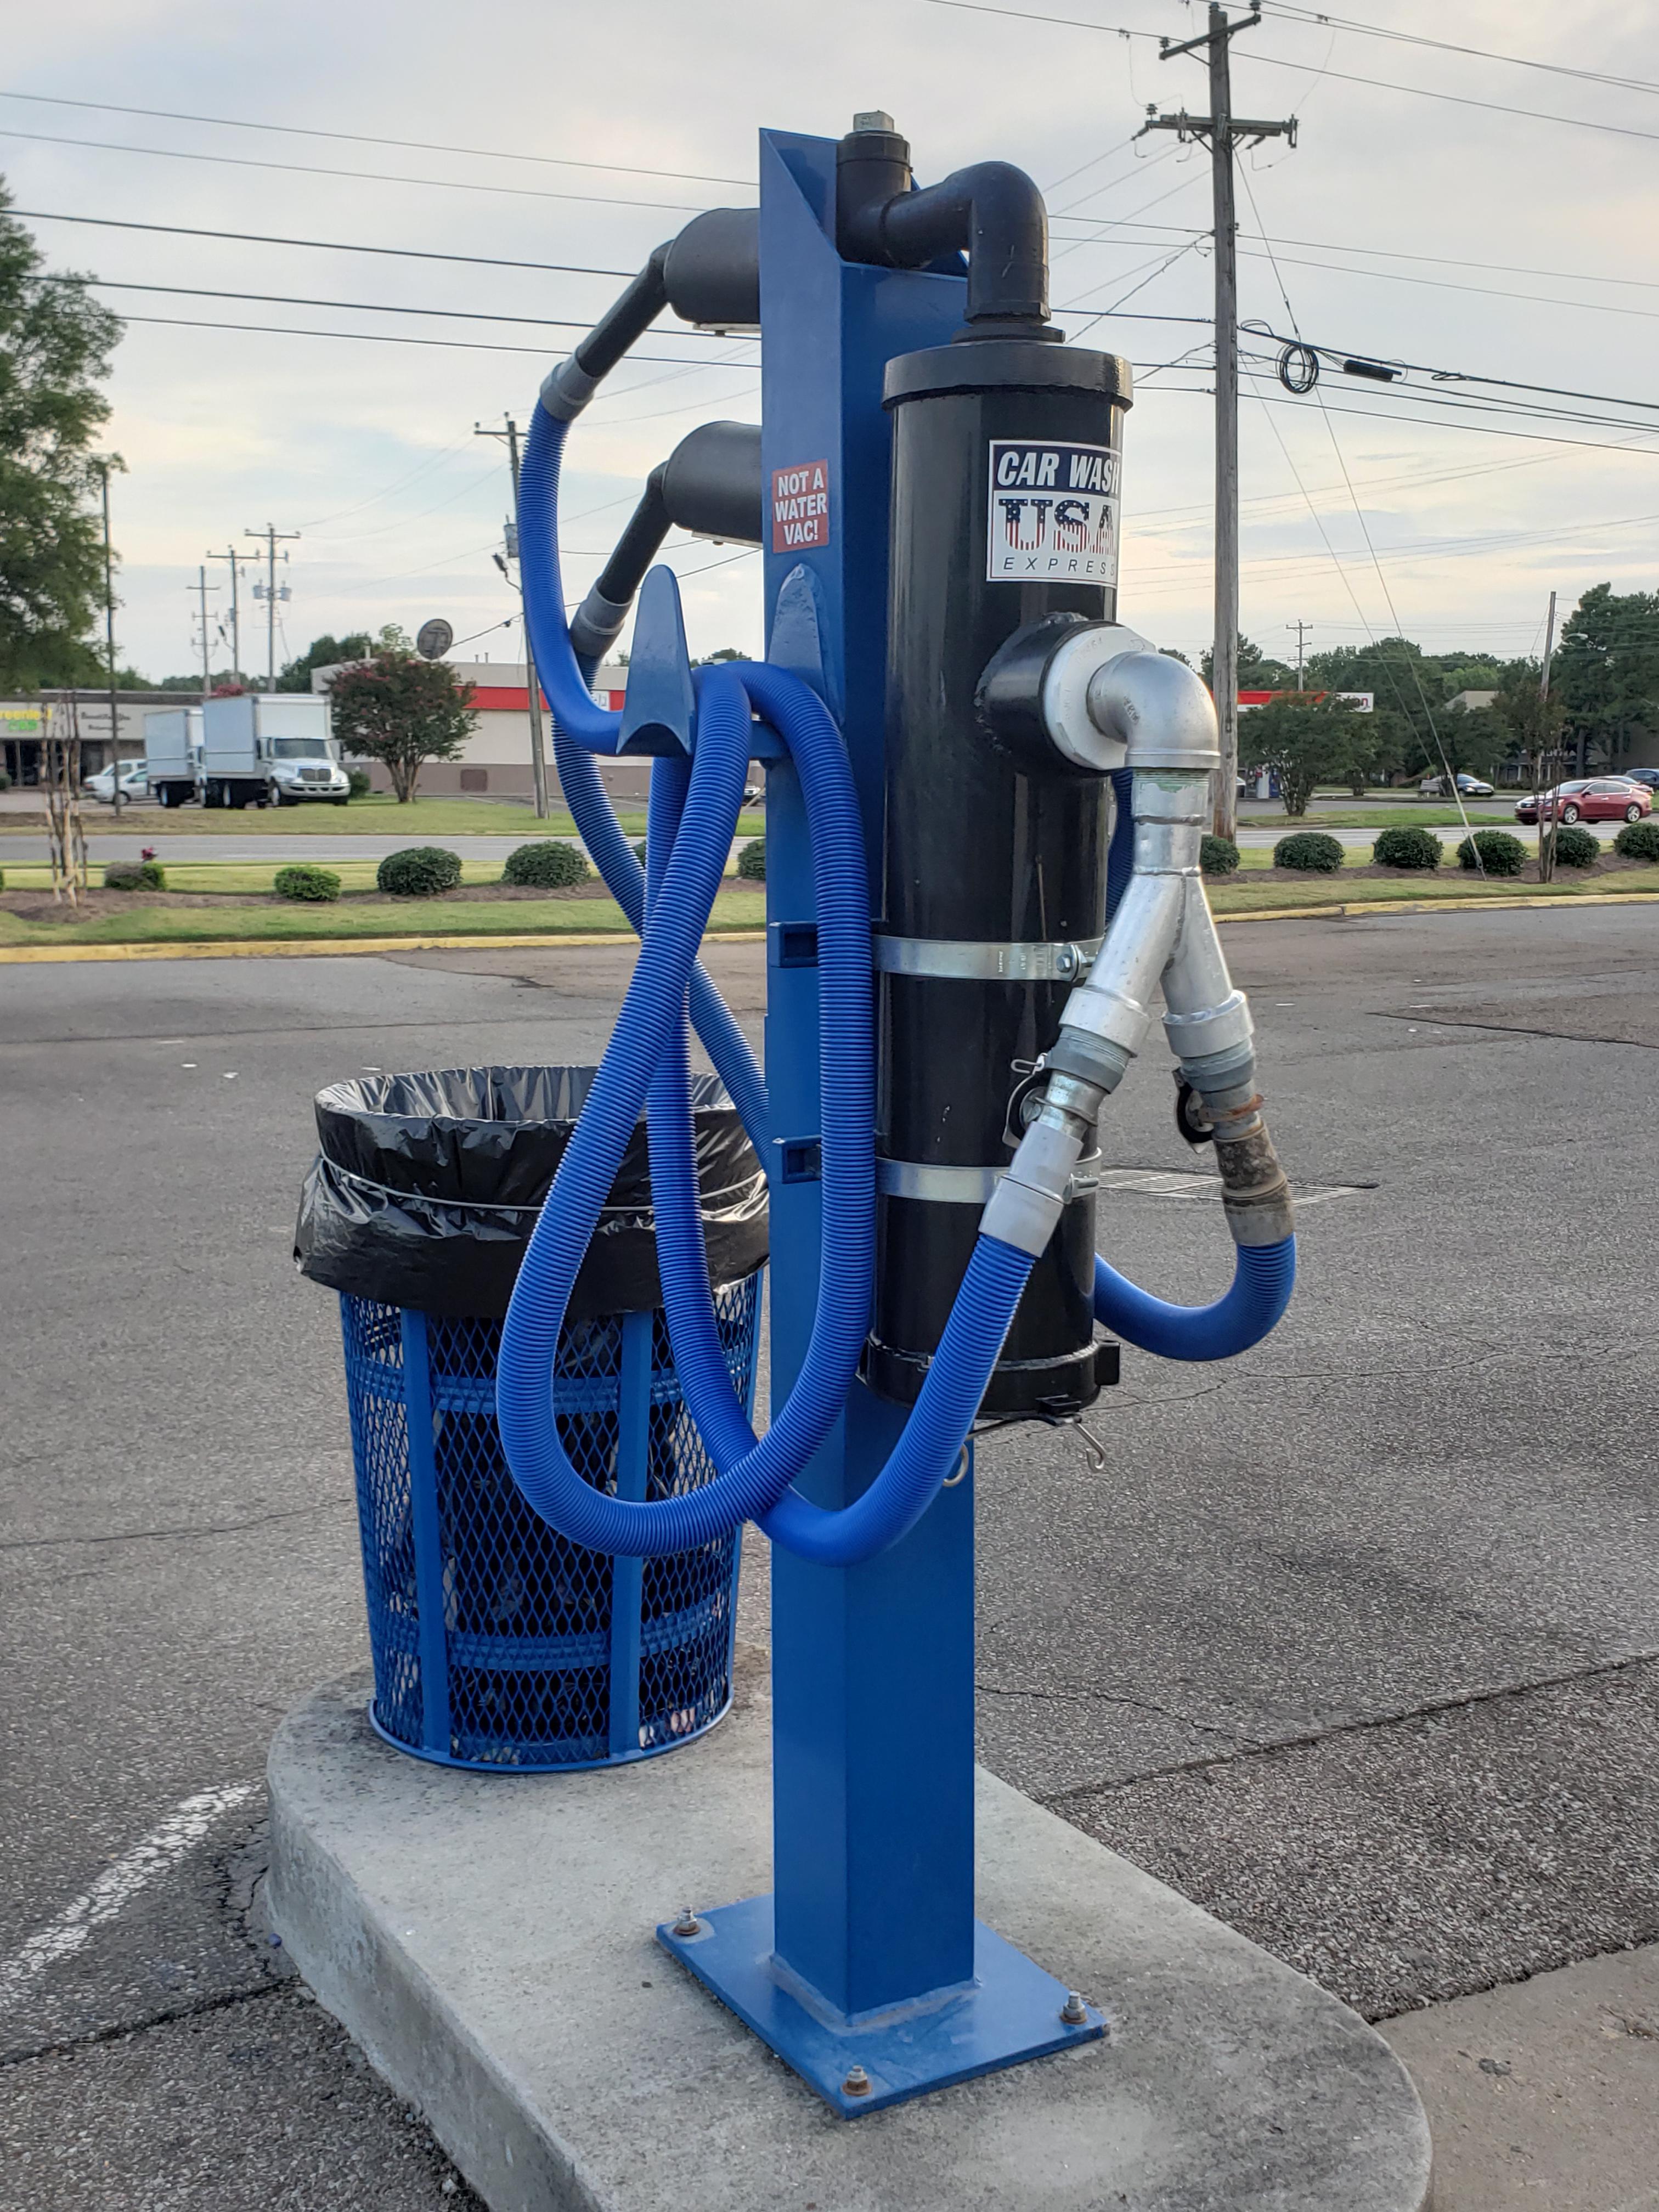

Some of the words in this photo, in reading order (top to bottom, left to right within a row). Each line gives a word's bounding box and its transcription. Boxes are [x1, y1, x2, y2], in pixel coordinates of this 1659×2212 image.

[778, 471, 809, 497] NOT
[812, 468, 824, 490] A
[997, 451, 1059, 486] CAR
[1069, 454, 1120, 495] WASH
[775, 493, 827, 522] WATER
[783, 520, 819, 545] VAC!
[998, 498, 1116, 556] USA
[1003, 557, 1114, 576] EXPRESS
